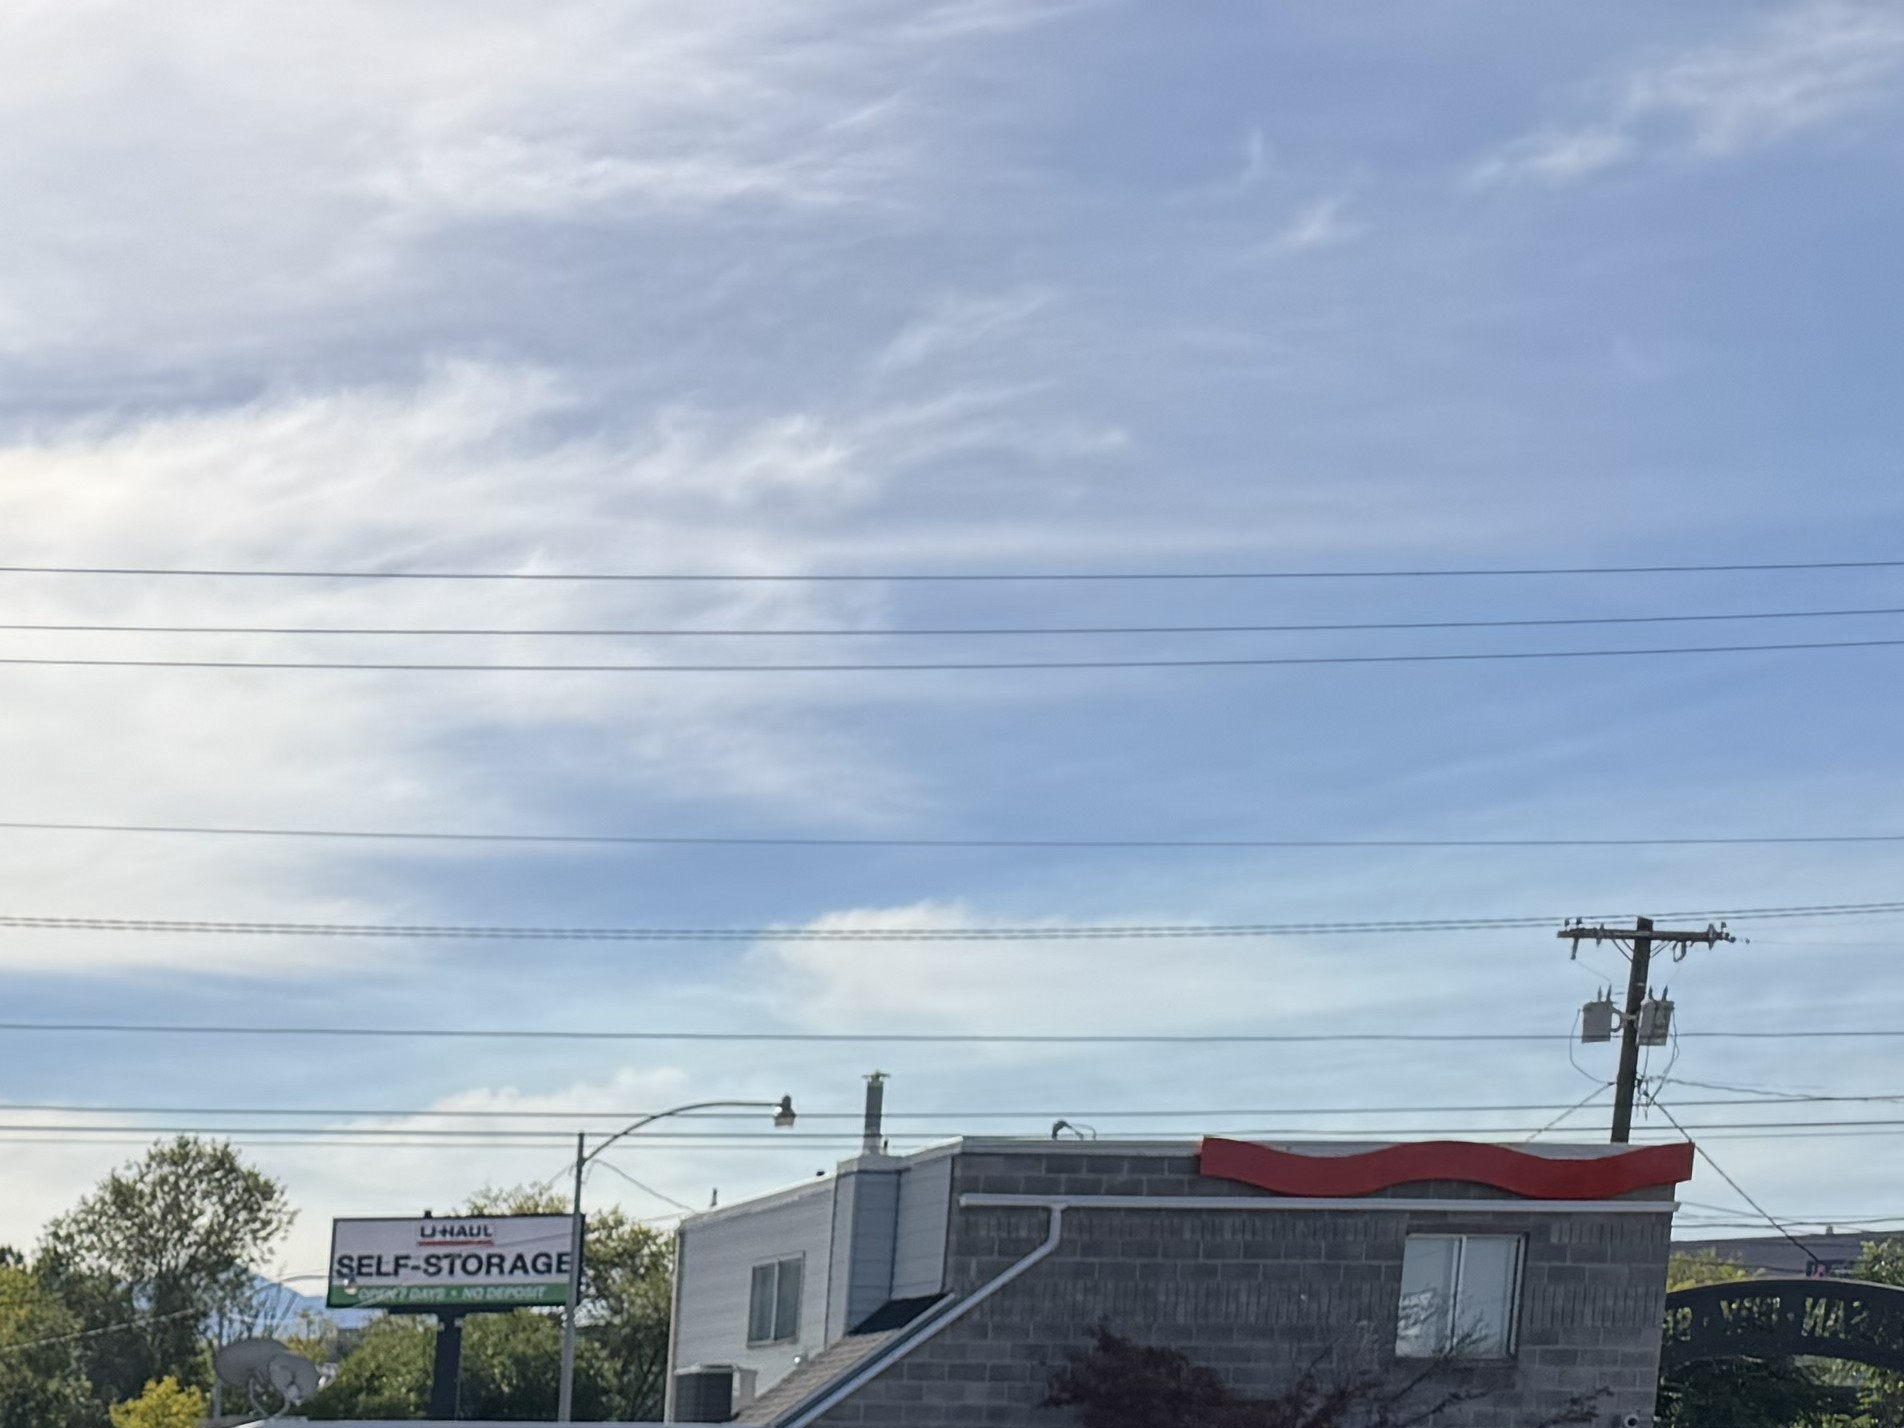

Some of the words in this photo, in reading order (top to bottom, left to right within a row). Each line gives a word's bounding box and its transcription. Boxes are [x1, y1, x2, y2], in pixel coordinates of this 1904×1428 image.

[420, 1224, 493, 1238] U-HAUL
[336, 1252, 572, 1278] SELF-STORAGE
[408, 1286, 447, 1300] DAYS
[461, 1286, 484, 1299] NO
[485, 1285, 547, 1299] DEPOSIT
